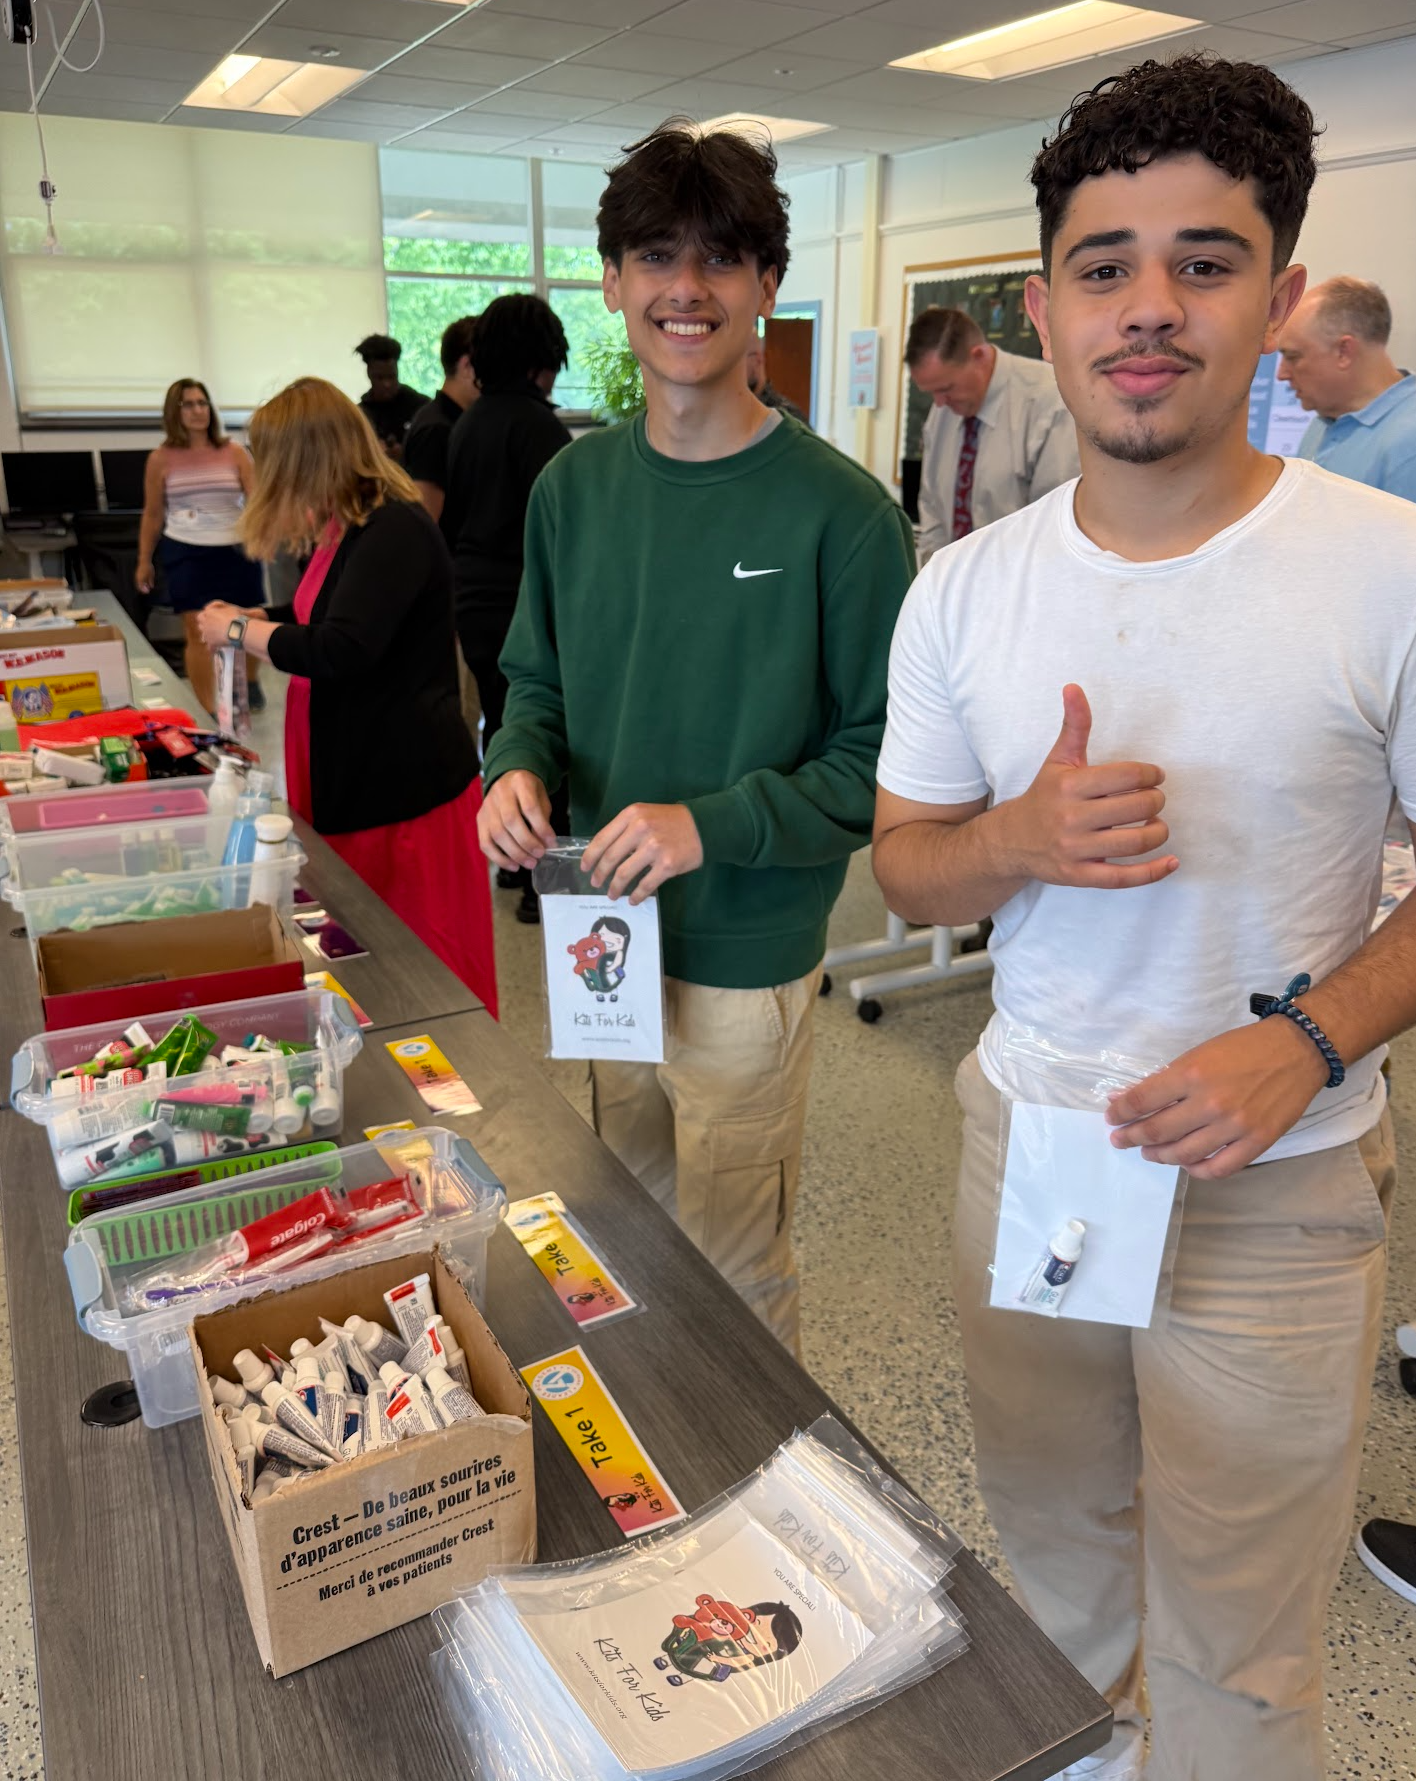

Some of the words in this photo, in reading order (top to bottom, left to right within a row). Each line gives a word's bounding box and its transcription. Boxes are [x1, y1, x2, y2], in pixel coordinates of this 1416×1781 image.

[229, 1013, 281, 1027] COMPANY
[594, 1012, 615, 1027] For
[420, 1064, 441, 1084] Take
[270, 1212, 326, 1248] Colgate
[545, 1242, 575, 1277] Take
[564, 1406, 584, 1418] 1
[577, 1419, 613, 1469] Take
[292, 1513, 341, 1545] Crest
[363, 1500, 385, 1519] De
[388, 1480, 436, 1509] beaux
[440, 1455, 502, 1488] sourires
[386, 1505, 433, 1532] saine,
[437, 1487, 472, 1515] pour
[476, 1479, 491, 1497] la
[494, 1469, 516, 1489] vie
[773, 1508, 804, 1539] Kids
[318, 1575, 354, 1601] Merci
[359, 1569, 374, 1585] de
[377, 1535, 459, 1578] recommander
[462, 1518, 495, 1542] Crest
[801, 1529, 825, 1560] For
[367, 1584, 376, 1597] à
[378, 1574, 400, 1592] vos
[403, 1552, 453, 1585] patients
[822, 1550, 851, 1581] Kits
[773, 1567, 785, 1580] YOU
[784, 1578, 796, 1590] ARE
[793, 1588, 817, 1612] SPECIAL!
[575, 1651, 628, 1720] www.kitsforkids.org
[593, 1637, 623, 1662] Kits
[616, 1662, 643, 1691] For
[635, 1692, 671, 1722] Kids
